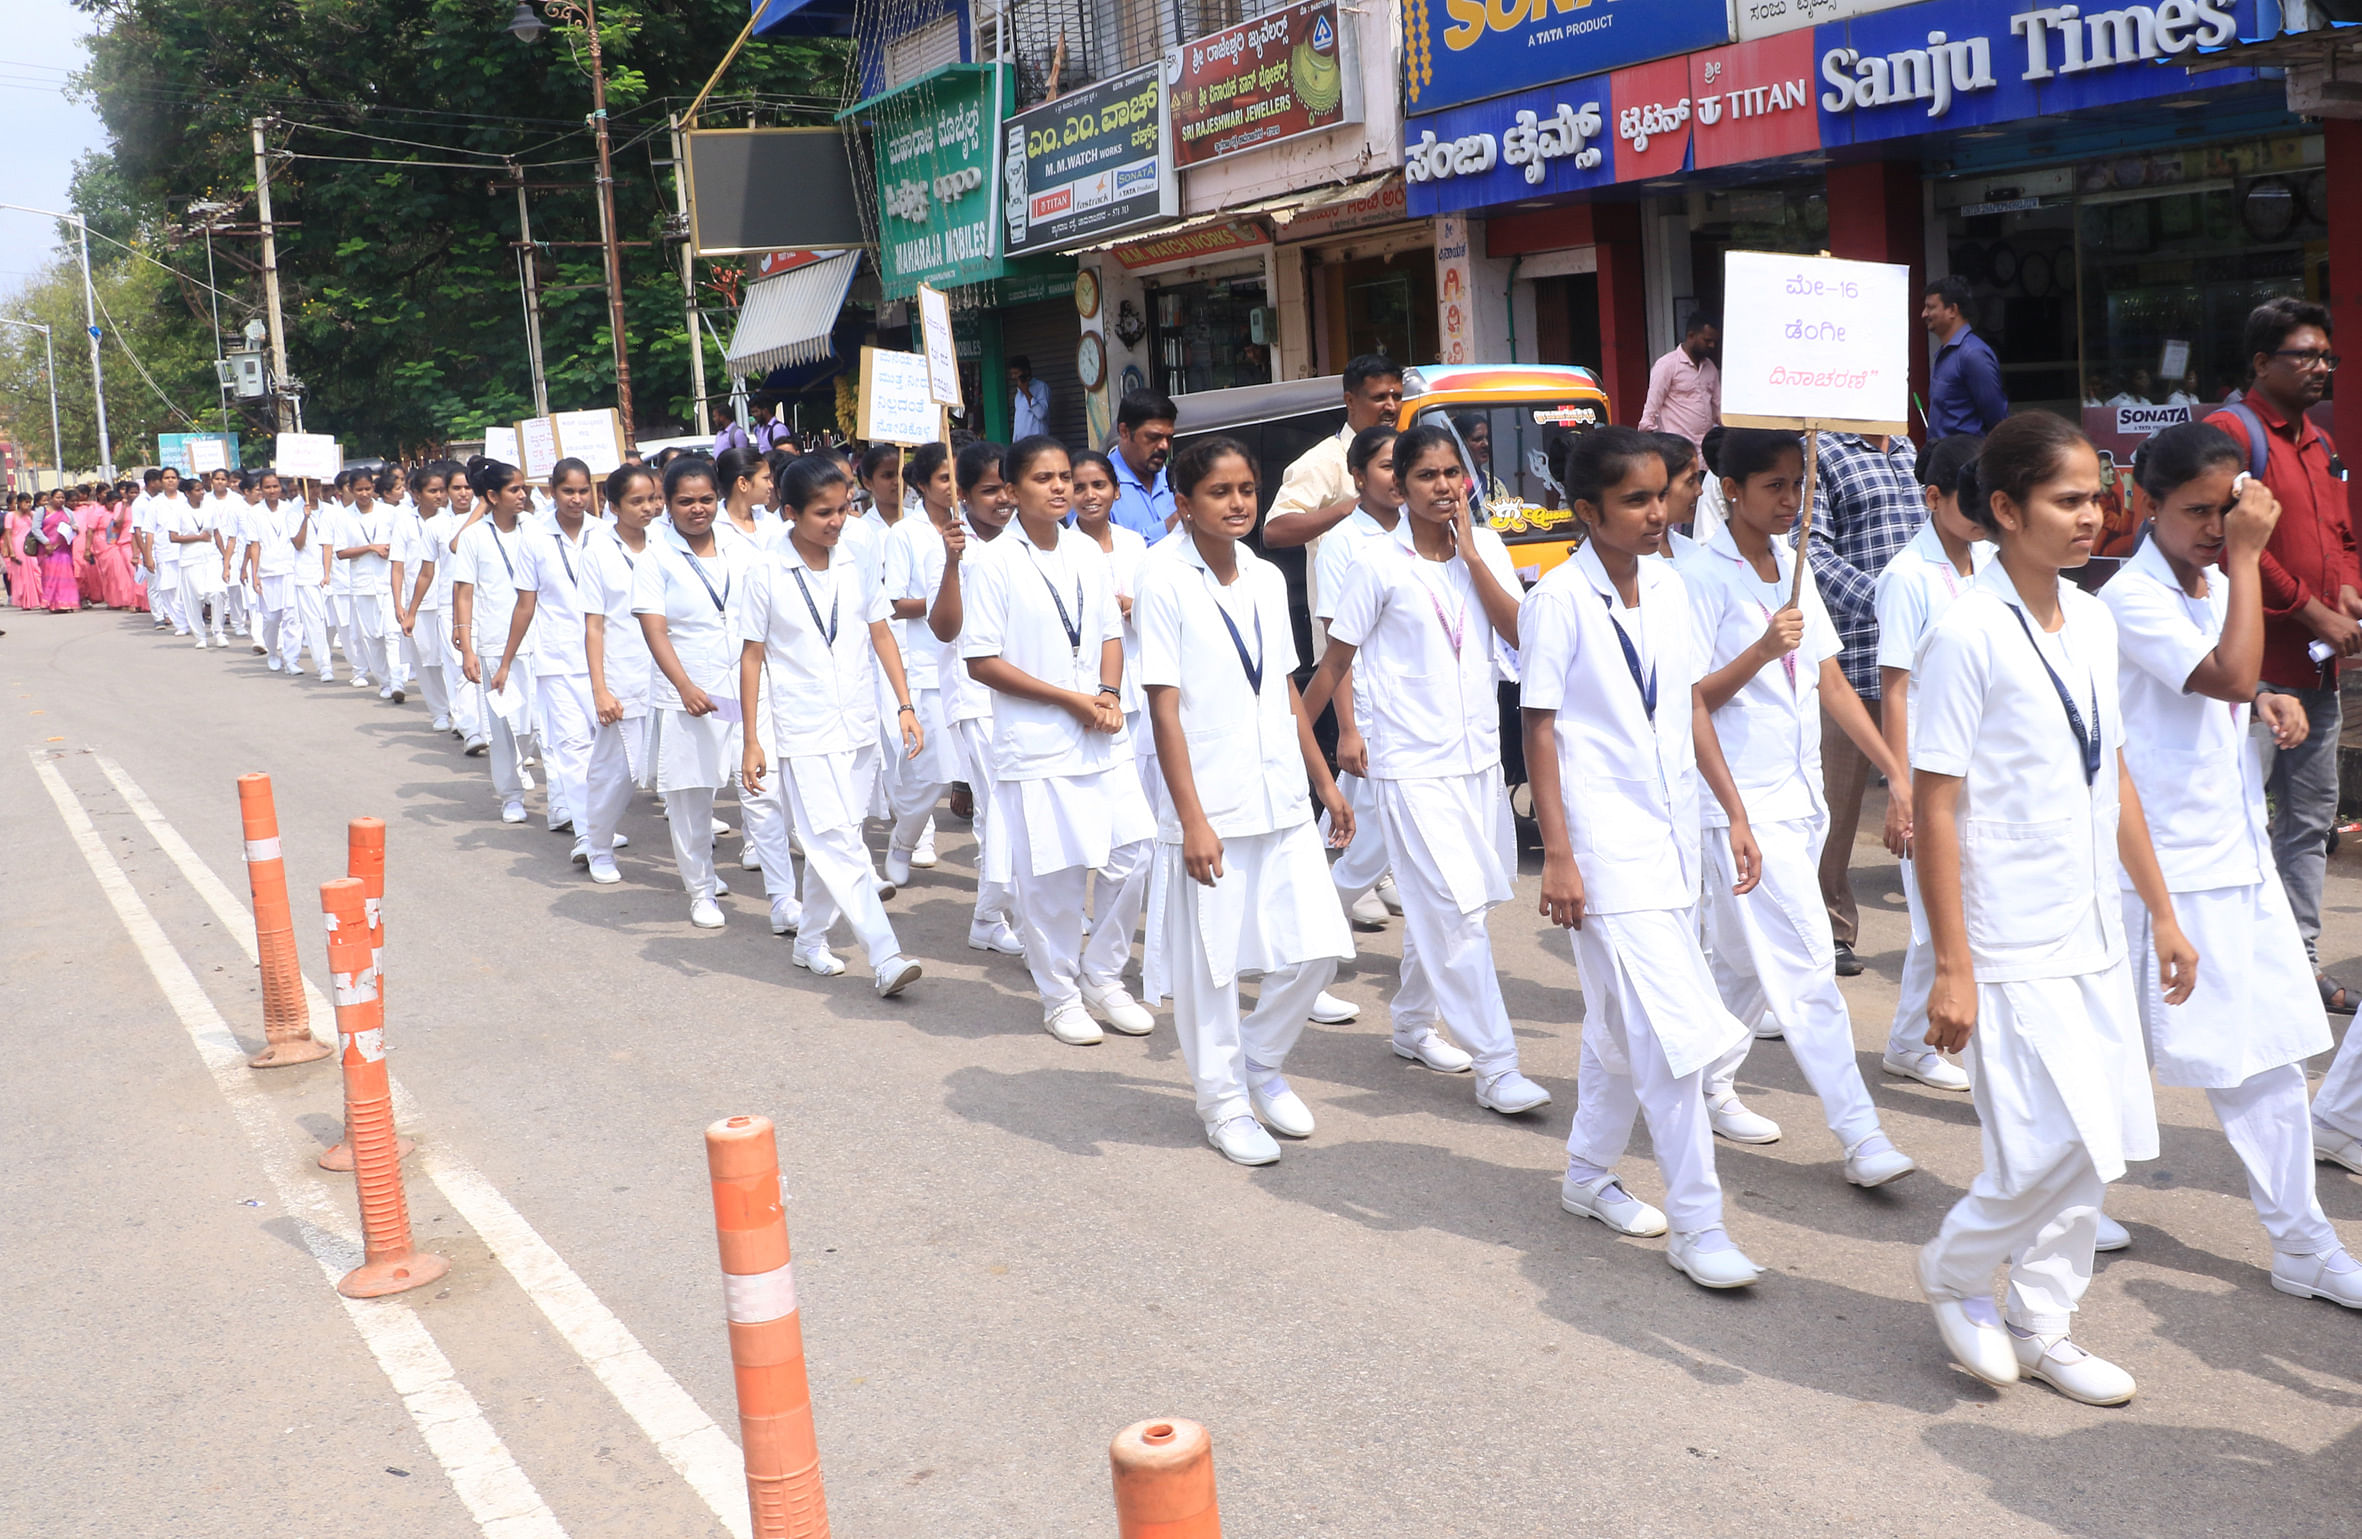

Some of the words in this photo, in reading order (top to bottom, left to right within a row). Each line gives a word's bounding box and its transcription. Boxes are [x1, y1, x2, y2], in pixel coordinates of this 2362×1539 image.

[1528, 35, 1536, 48] A
[1537, 27, 1563, 45] TATA
[1566, 14, 1613, 38] PRODUCT
[1192, 47, 1204, 74] ಶ್ರೀ
[1704, 61, 1721, 84] ಶ್ರೀ
[1821, 30, 1997, 117] Sanju
[2010, 0, 2237, 81] Times
[1101, 81, 1158, 133] ವಾಚ್
[1726, 79, 1806, 119] TITAN
[1182, 124, 1195, 142] SRI
[1195, 109, 1244, 138] RAJESHWARI
[1244, 94, 1292, 123] JEWELLERS
[1620, 98, 1691, 152] ಟೈಟನ್
[1100, 144, 1123, 160] WORKS
[1405, 130, 1497, 184] ಸಂಜು
[1503, 102, 1601, 184] ಟೈಮ್ಸ್
[1118, 164, 1154, 184] SONATA
[1046, 195, 1068, 211] TITAN
[1076, 194, 1109, 211] fastrack
[1122, 188, 1136, 197] TATA
[895, 233, 943, 275] MAHARAJA
[945, 221, 986, 264] MOBILES
[1146, 238, 1191, 258] WATCH
[1187, 229, 1237, 248] WORKS
[2120, 407, 2189, 424] SONATA
